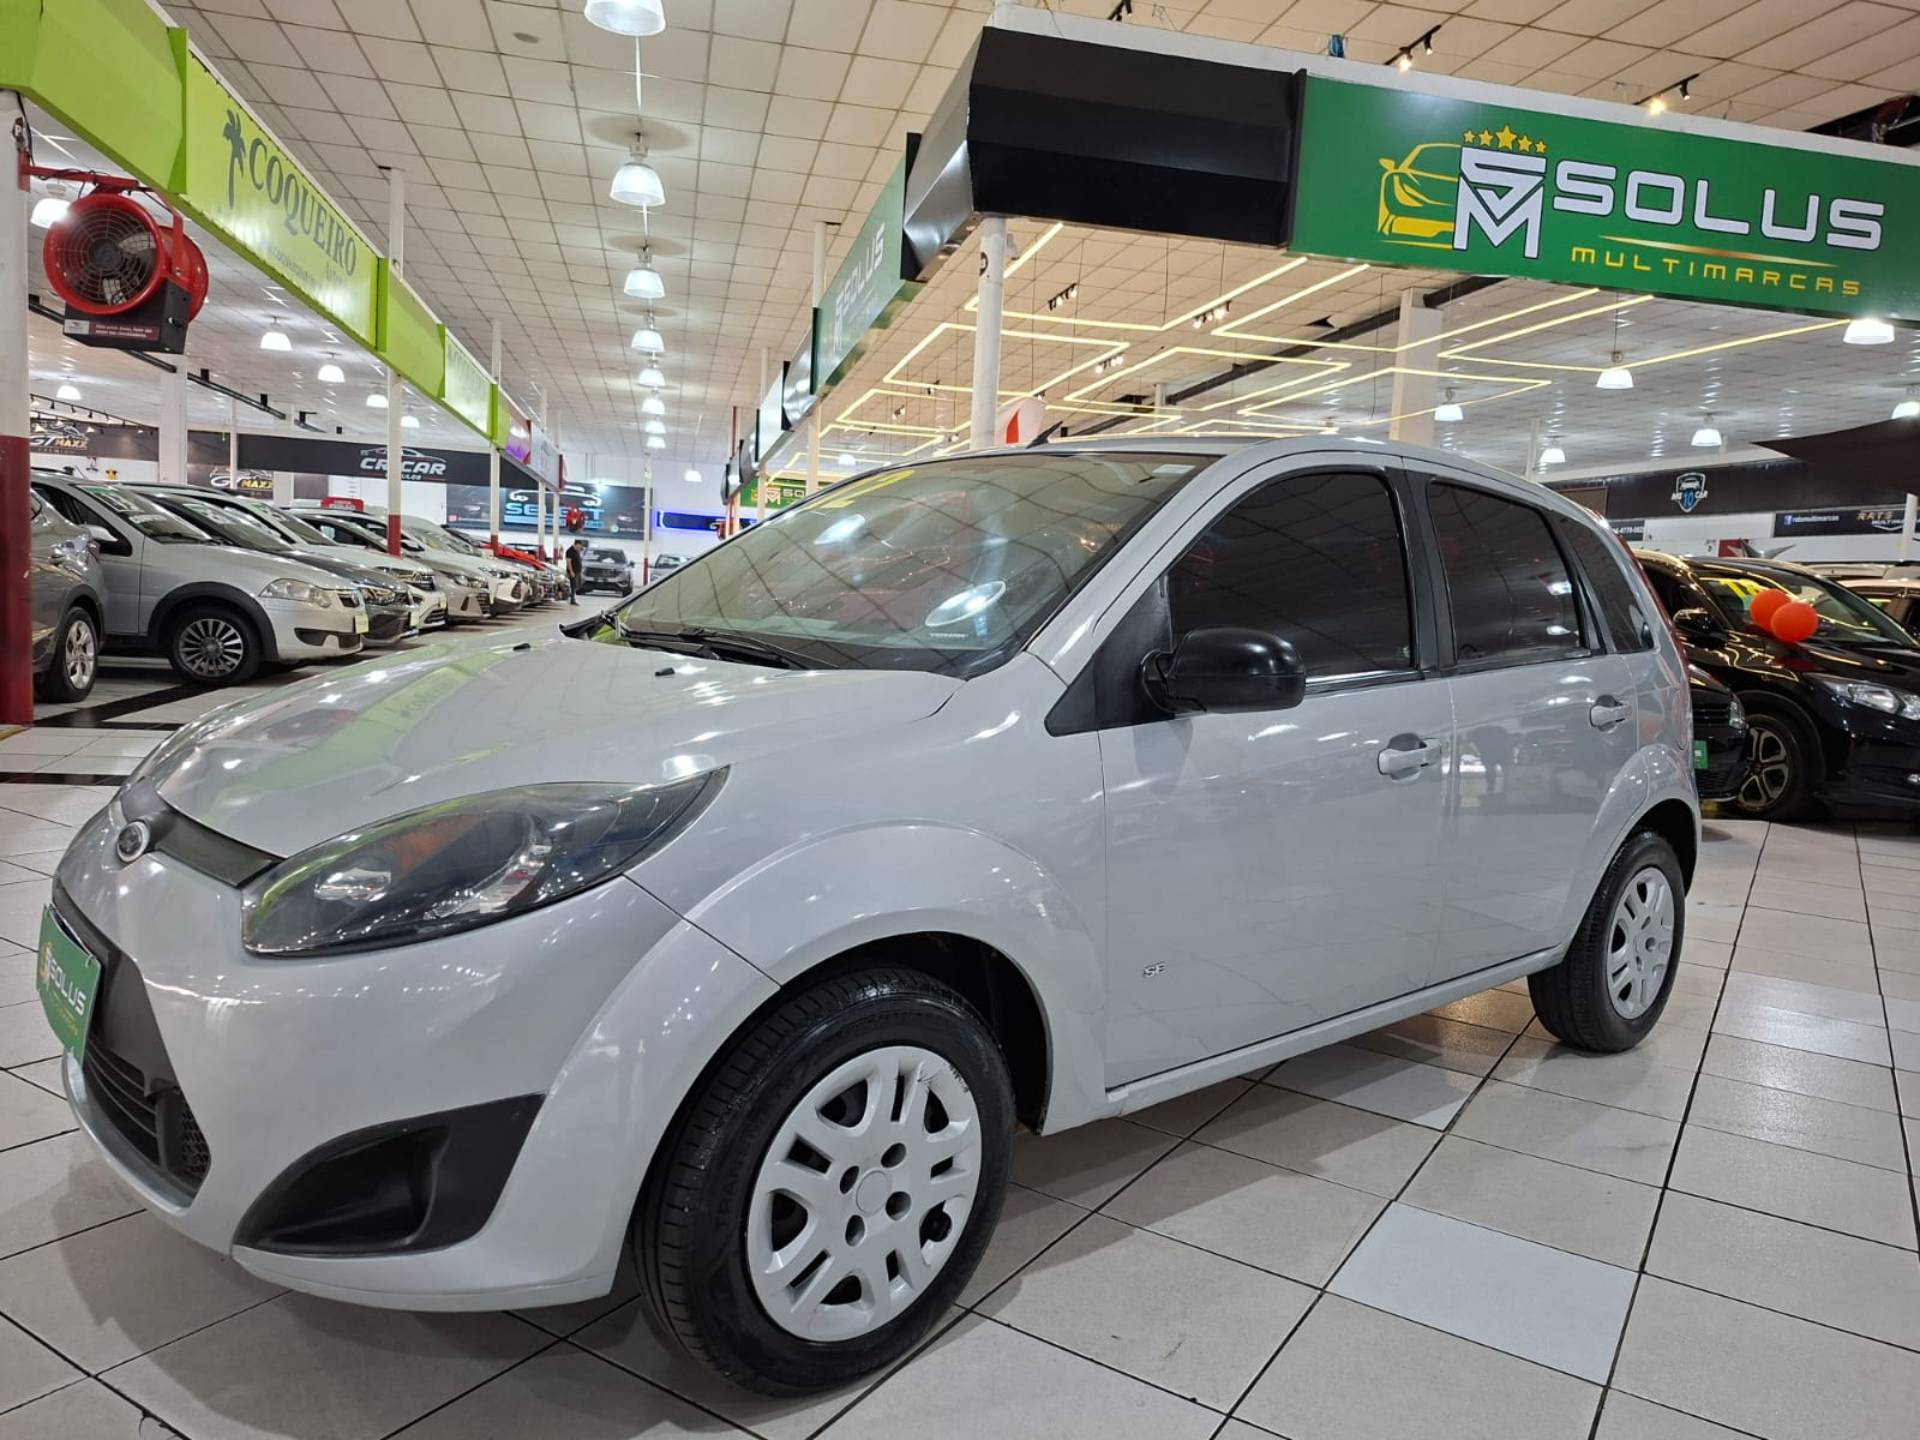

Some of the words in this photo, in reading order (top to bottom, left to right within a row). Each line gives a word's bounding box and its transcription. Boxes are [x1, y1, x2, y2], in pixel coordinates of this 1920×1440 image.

[249, 137, 357, 277] COQUEIRO
[1552, 159, 1885, 251] SOLUS
[842, 222, 886, 317] SOLUS
[1571, 246, 1861, 296] MULTIMARCAS
[50, 957, 87, 1016] SOLUS
